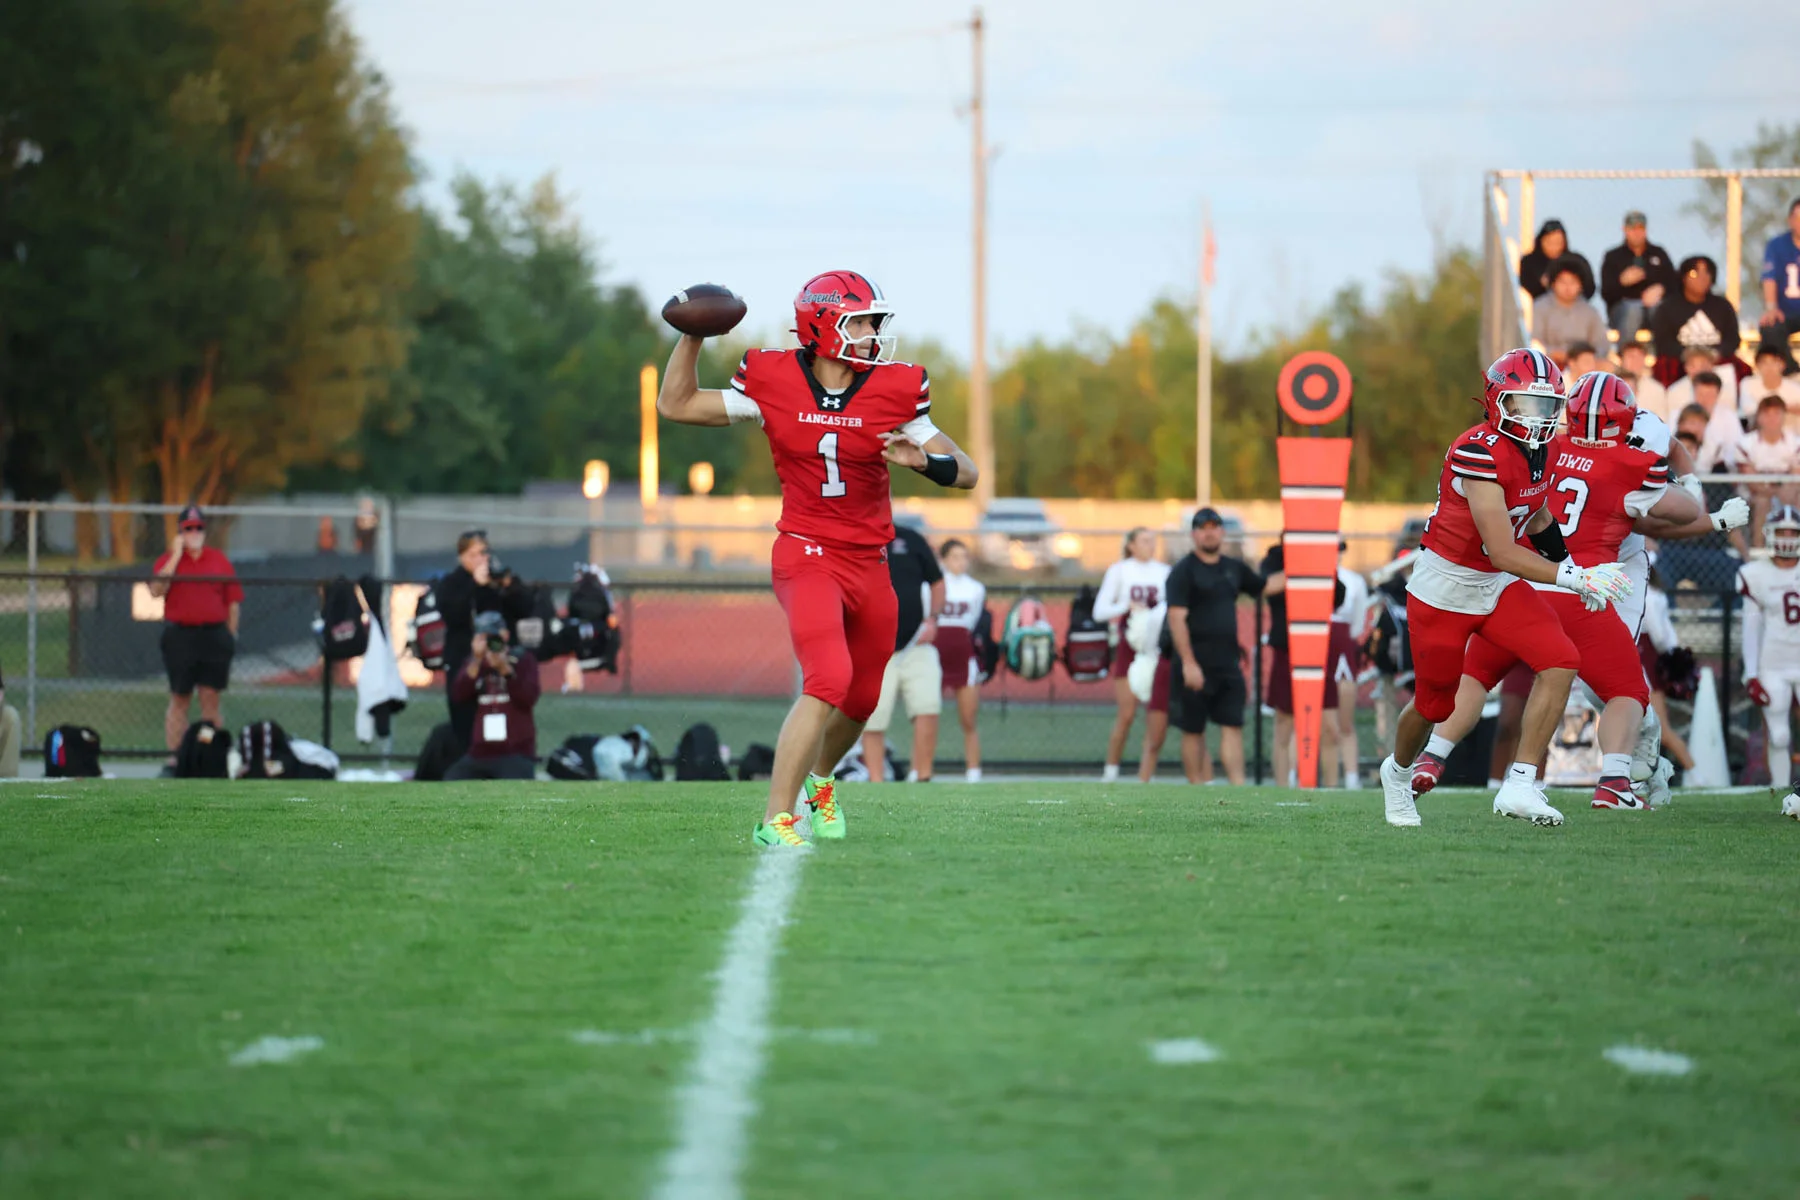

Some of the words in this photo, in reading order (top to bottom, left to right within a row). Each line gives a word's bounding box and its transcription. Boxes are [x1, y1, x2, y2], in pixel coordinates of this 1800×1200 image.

[798, 412, 862, 428] LANCASTER
[1469, 431, 1500, 447] 34
[1576, 439, 1608, 448] Riddell
[817, 432, 847, 498] 1
